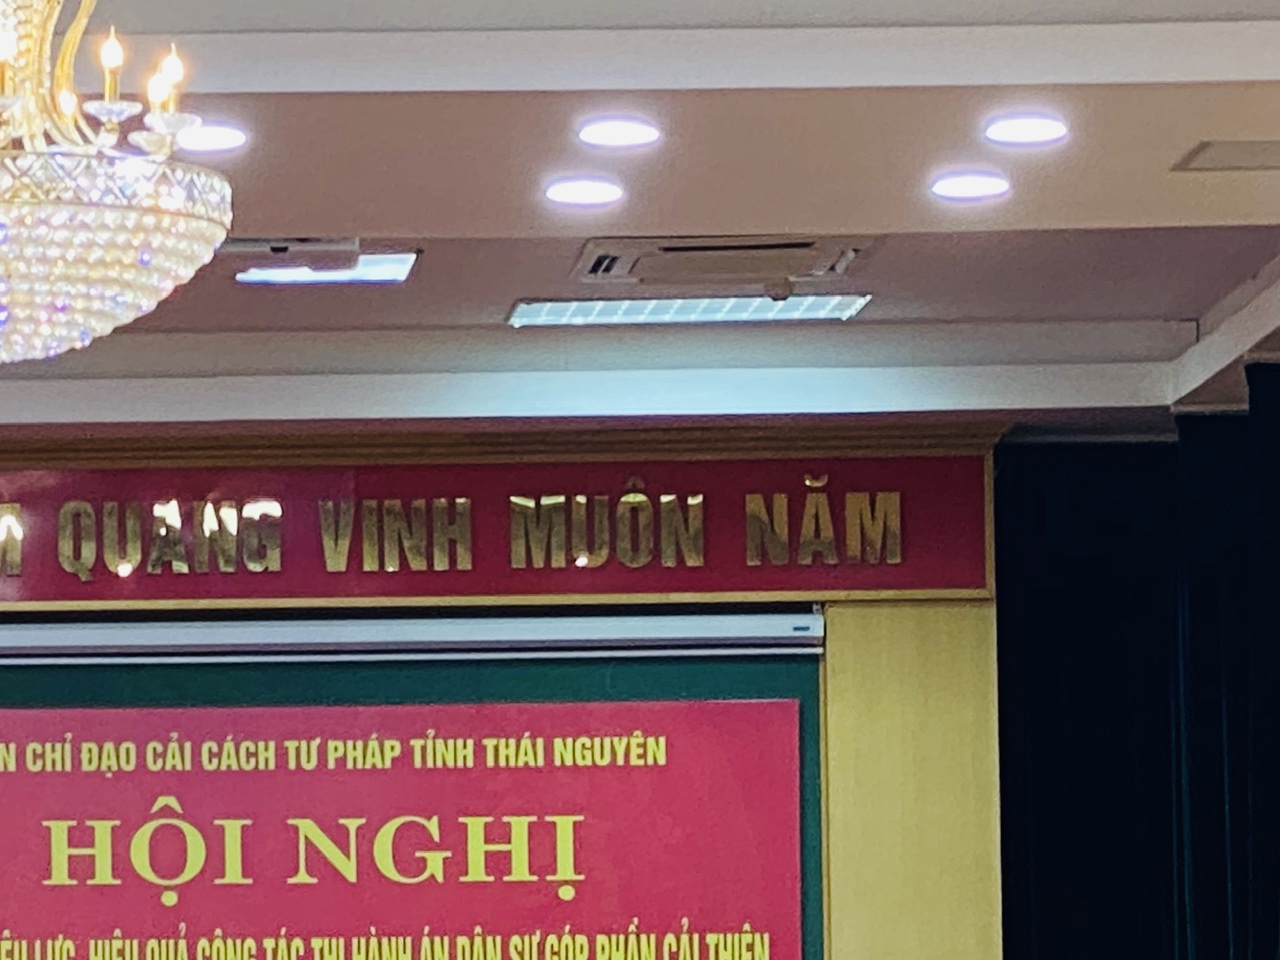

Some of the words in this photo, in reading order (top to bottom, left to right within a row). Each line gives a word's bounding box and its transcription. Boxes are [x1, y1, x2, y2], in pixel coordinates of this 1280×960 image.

[57, 498, 283, 582] QUANG
[320, 496, 472, 573] VINH
[509, 476, 705, 570] MUÔN
[745, 473, 902, 566] NĂM
[25, 733, 72, 773] CHỈ
[80, 741, 137, 778] ĐẠO
[146, 732, 192, 772] CẢI
[201, 736, 276, 771] CÁCH
[283, 737, 321, 771] TƯ
[327, 734, 402, 770] PHÁP
[409, 729, 475, 769] TỈNH
[481, 732, 545, 768] THÁI
[553, 730, 667, 767] NGUYÊN
[41, 795, 253, 907] HỘI
[286, 815, 585, 901] NGHỊ
